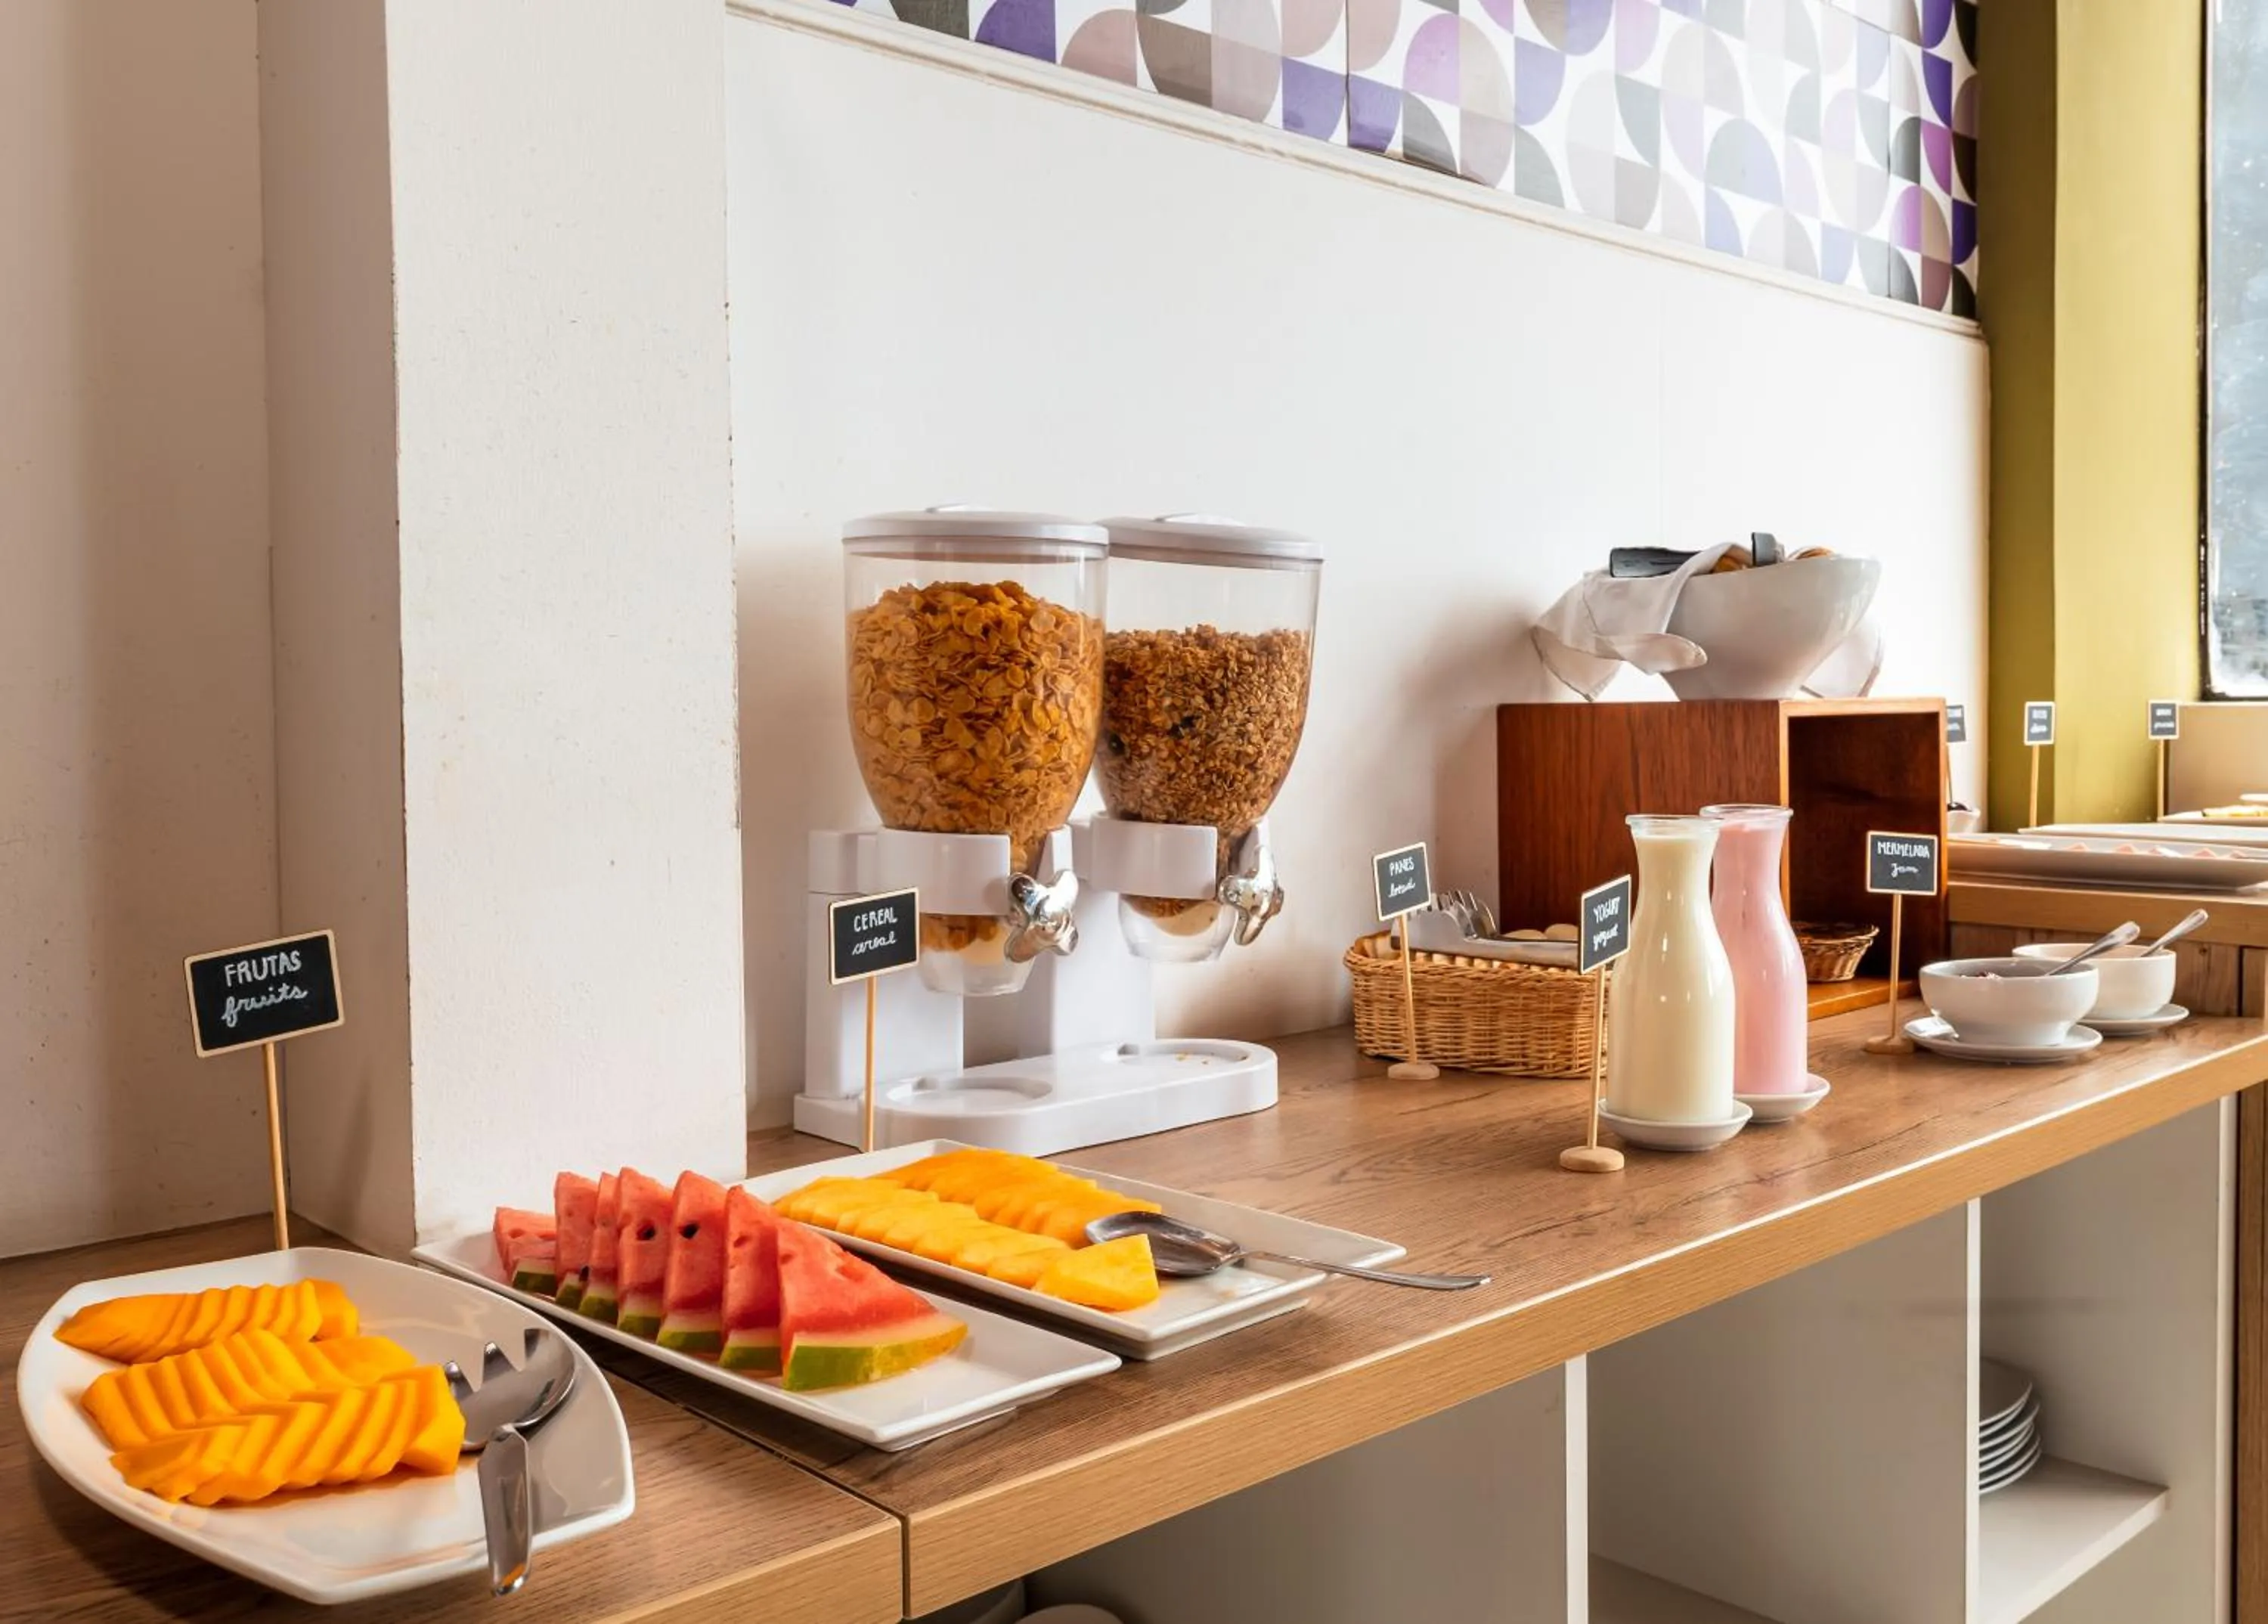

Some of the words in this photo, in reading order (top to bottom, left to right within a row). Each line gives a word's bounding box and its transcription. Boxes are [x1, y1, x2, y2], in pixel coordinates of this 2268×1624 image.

[1877, 841, 1930, 859] MERMELADA
[1389, 856, 1414, 876] PANES
[1388, 877, 1416, 898] bread
[854, 907, 898, 932] CEREAL
[851, 931, 897, 956] cereal
[224, 950, 302, 987] FRUTAS
[221, 983, 308, 1028] fruits
